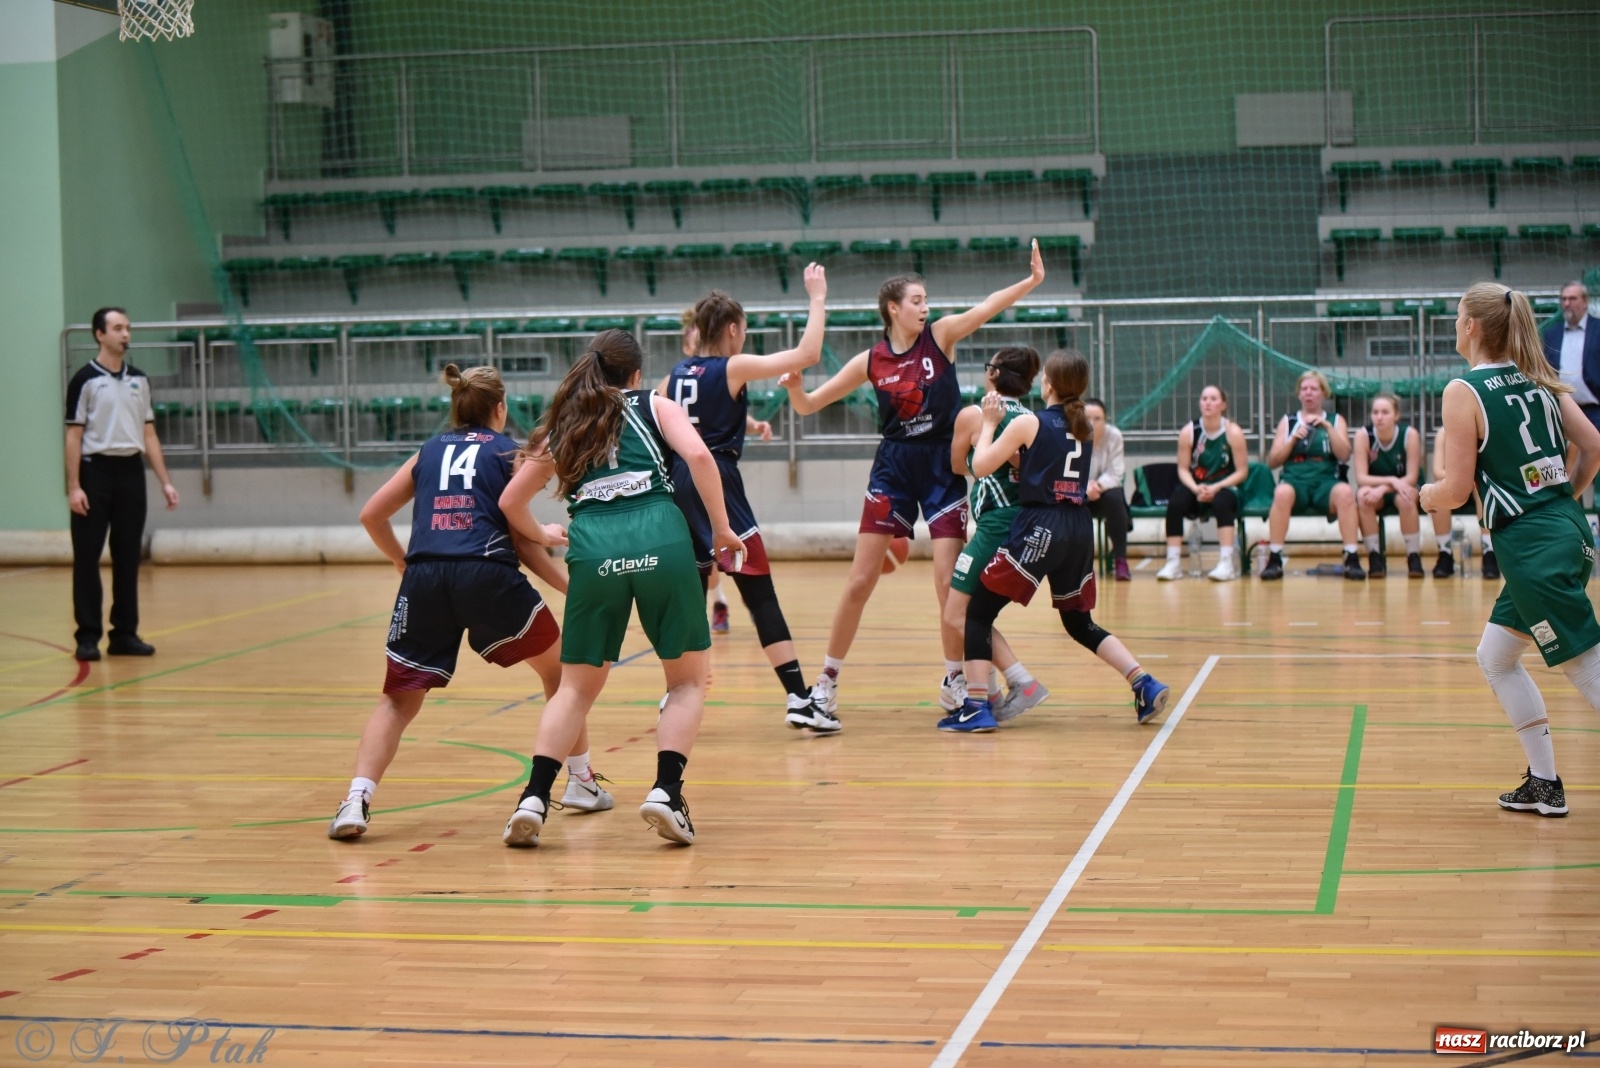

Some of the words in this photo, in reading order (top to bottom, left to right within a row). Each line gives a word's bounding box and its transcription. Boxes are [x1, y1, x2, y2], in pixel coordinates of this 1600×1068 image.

[922, 357, 934, 380] 9
[675, 379, 700, 424] 12
[1504, 388, 1557, 455] 27
[439, 444, 481, 491] 14
[1063, 432, 1082, 479] 2
[434, 494, 475, 509] KAMIENICA
[431, 512, 473, 531] POLSKA
[612, 554, 659, 573] Clavis
